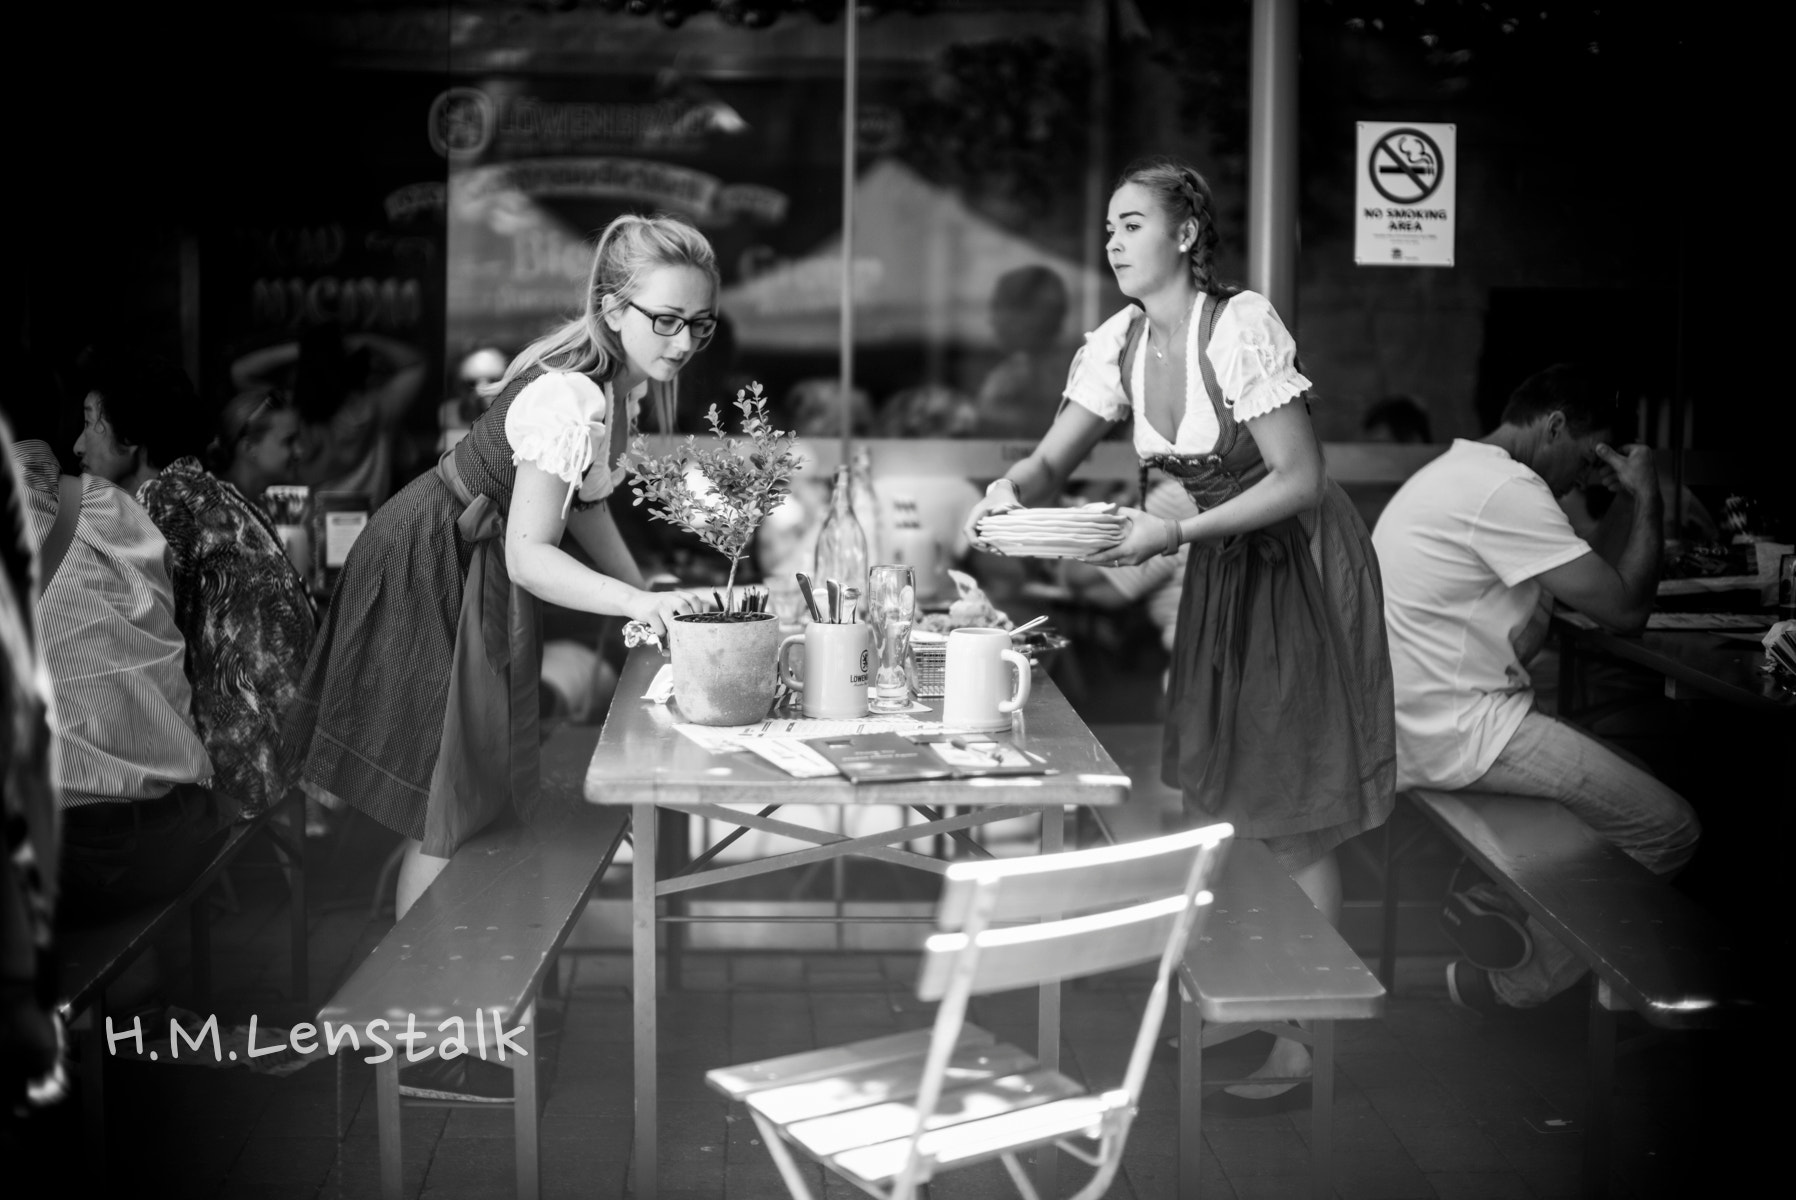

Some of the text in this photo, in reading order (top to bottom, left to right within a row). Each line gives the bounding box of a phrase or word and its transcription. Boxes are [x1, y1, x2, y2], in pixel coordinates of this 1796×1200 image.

[1364, 208, 1447, 220] NO SMOKING
[1389, 222, 1422, 231] AREA
